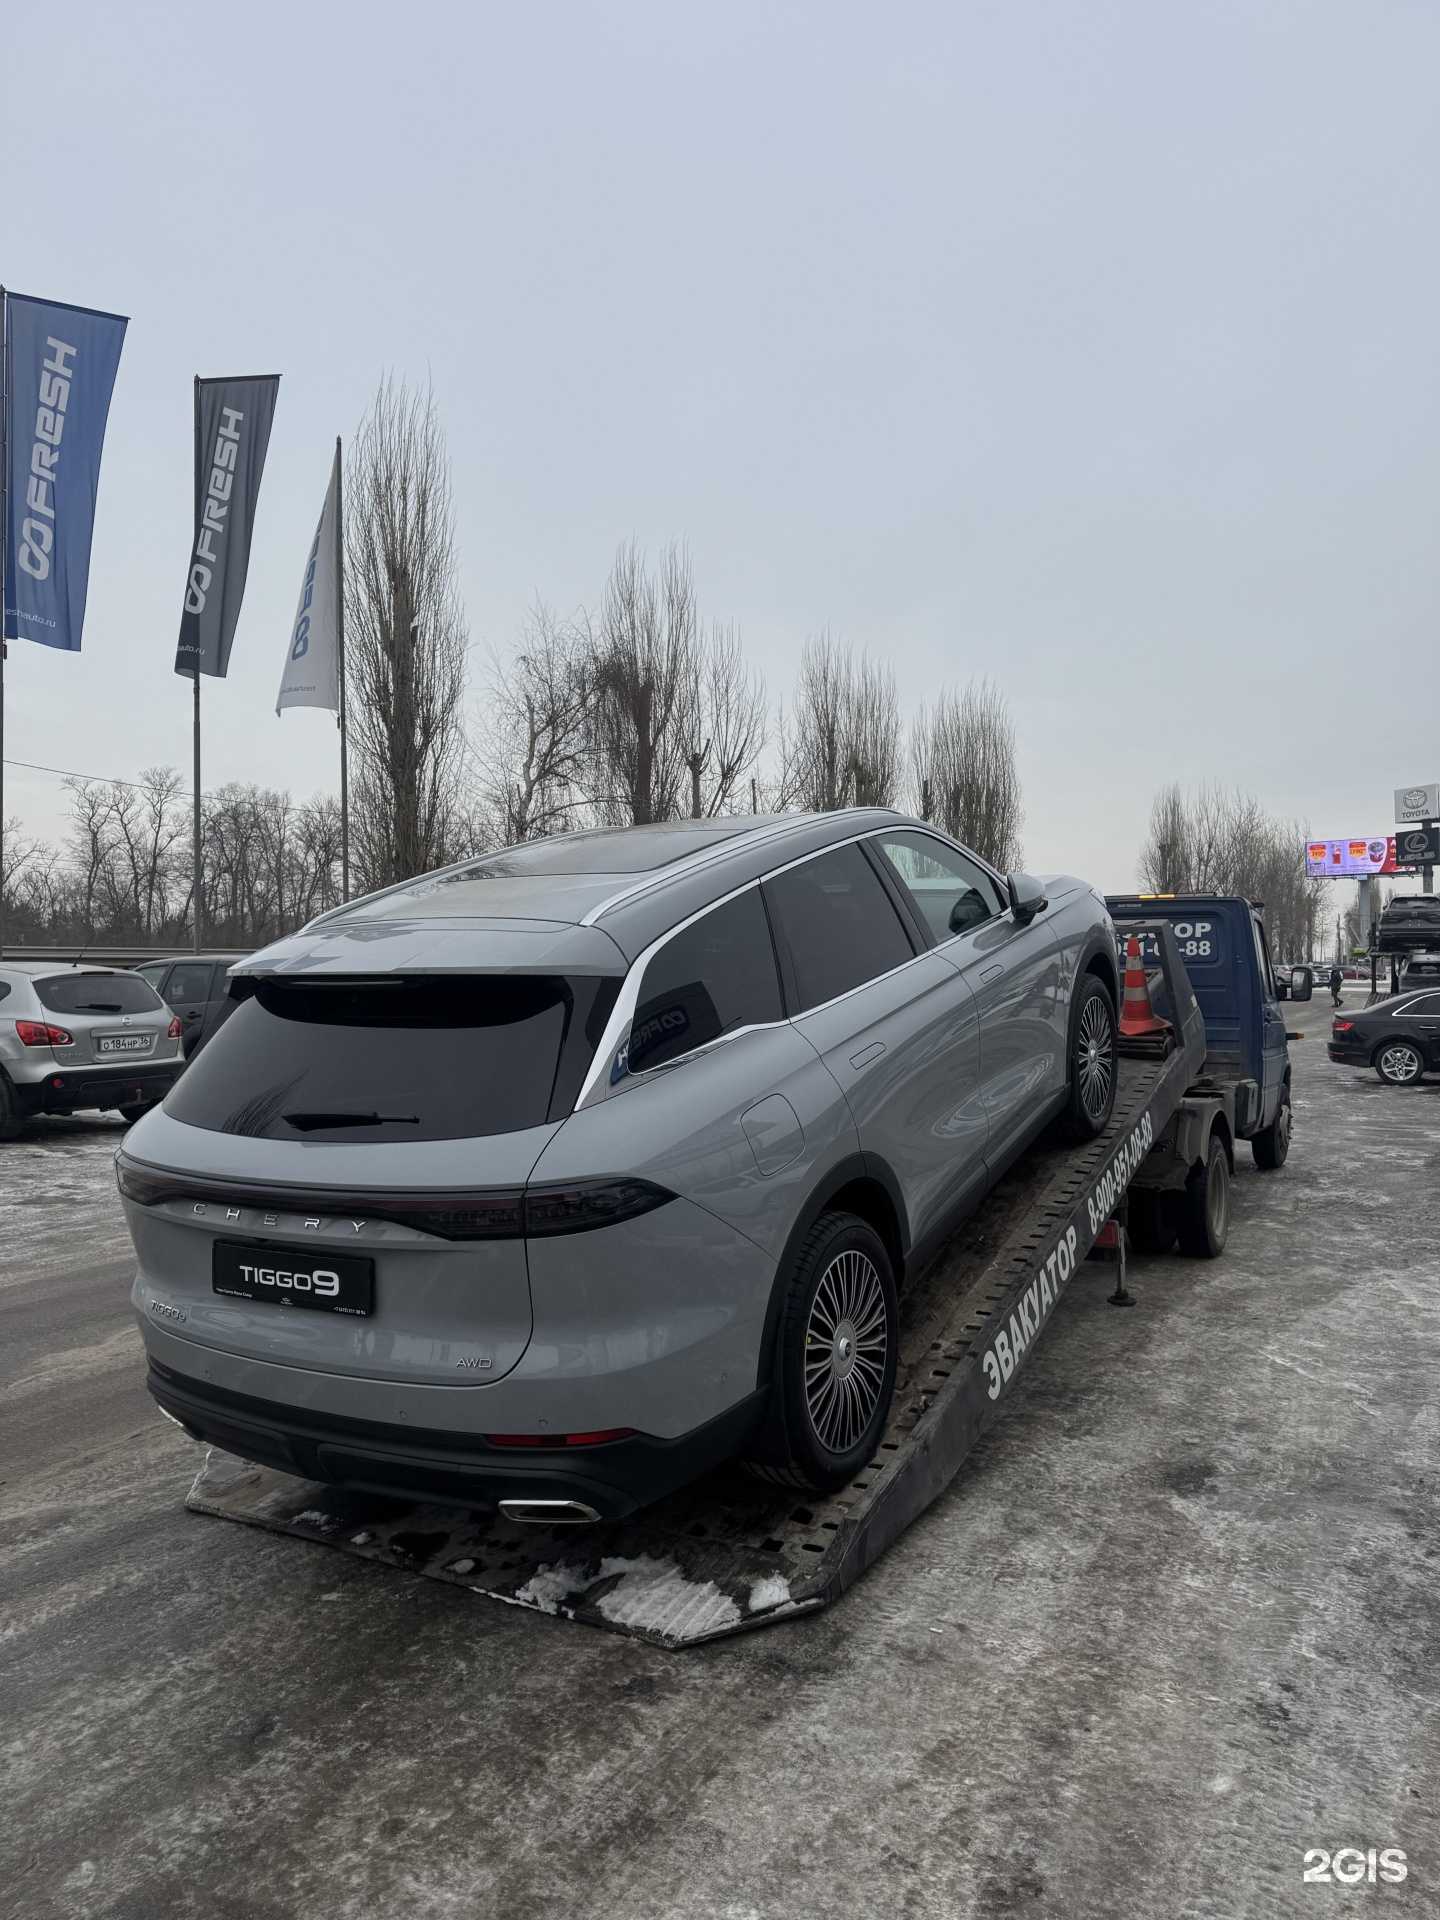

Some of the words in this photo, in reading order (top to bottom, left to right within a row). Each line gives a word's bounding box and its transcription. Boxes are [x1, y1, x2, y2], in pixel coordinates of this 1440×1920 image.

[1401, 809, 1430, 819] TOYOTA
[1087, 1111, 1153, 1235] 8-900-951-08-88
[192, 1201, 367, 1234] CHERY
[239, 1265, 340, 1296] TIGGO9
[982, 1225, 1077, 1401] ЭВАКУАТОР
[455, 1357, 493, 1370] AWD
